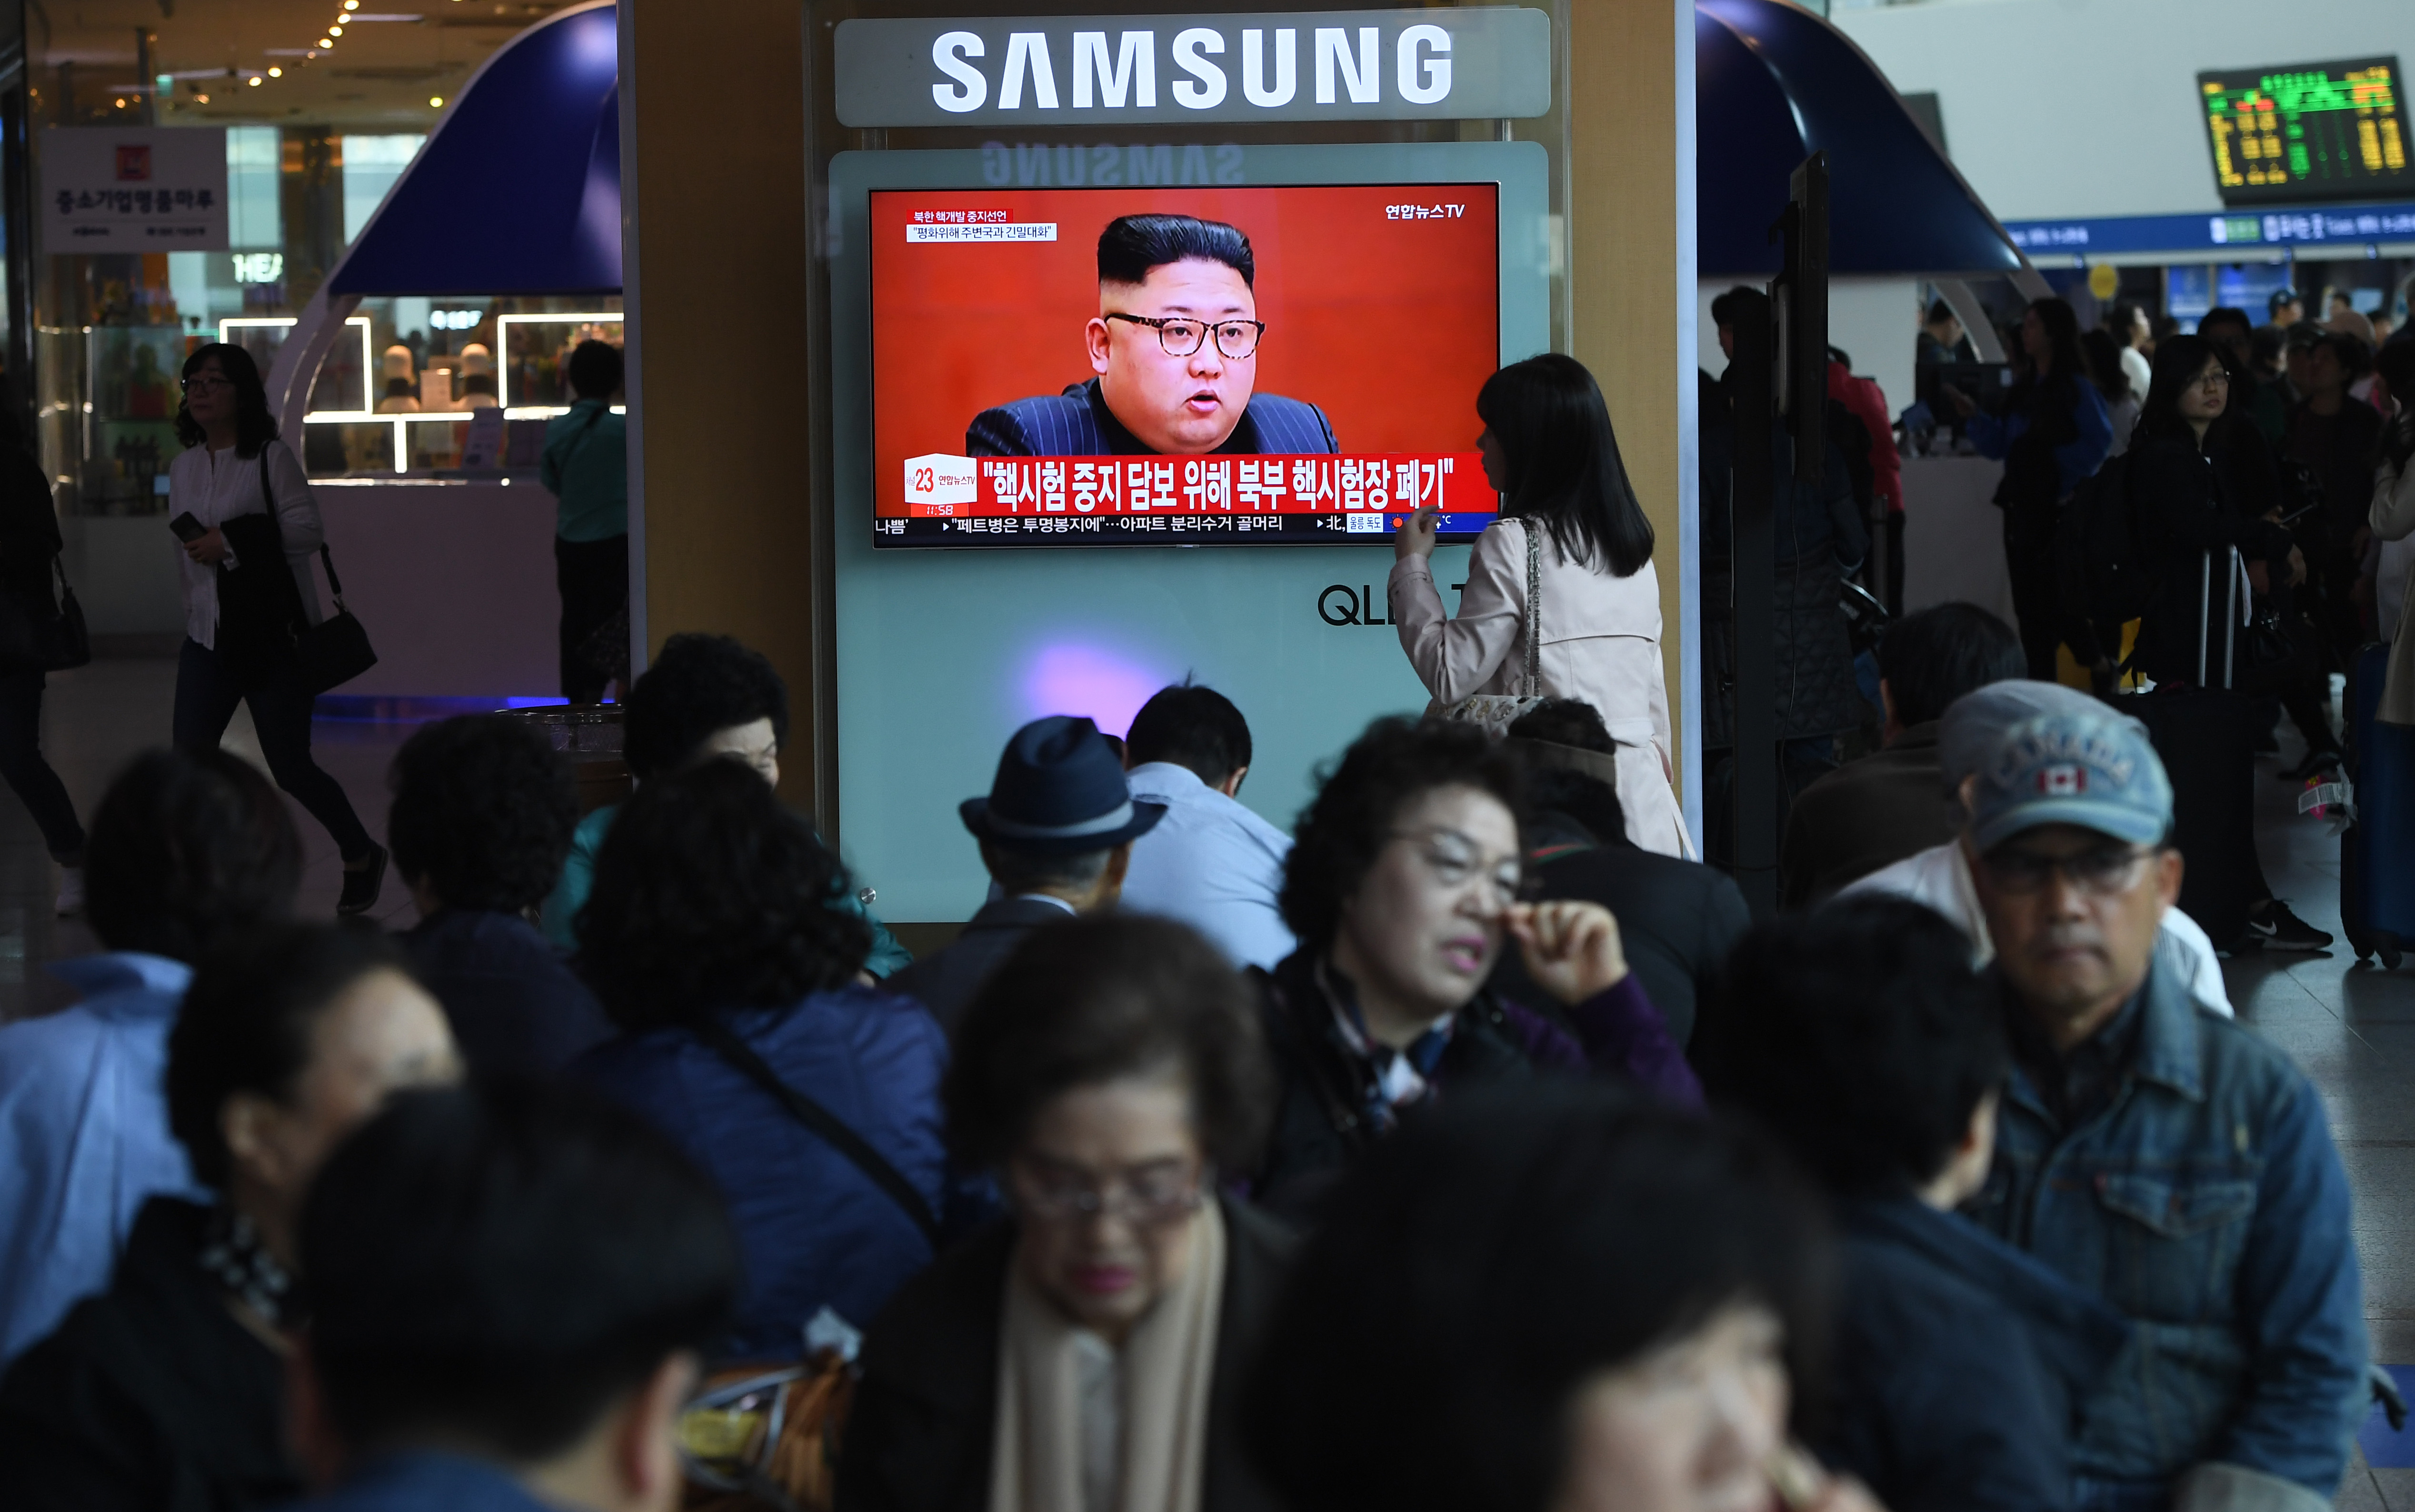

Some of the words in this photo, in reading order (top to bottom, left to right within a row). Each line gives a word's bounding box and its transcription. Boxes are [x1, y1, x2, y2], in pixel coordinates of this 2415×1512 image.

[932, 25, 1452, 113] SAMSUNG
[914, 211, 934, 222] 북한
[936, 211, 965, 222] 핵개발
[967, 210, 1006, 222] 중지선언
[1386, 204, 1465, 219] 연합뉴스TV
[913, 227, 959, 239] "평화위해
[961, 227, 1003, 239] 주변국과
[1006, 226, 1051, 238] 긴밀대화"
[916, 468, 934, 492] 23
[938, 475, 976, 486] 연합뉴스TV
[983, 461, 1066, 512] "핵시험
[1072, 461, 1121, 512] 중지
[1128, 461, 1177, 511] 담보
[1183, 460, 1231, 510] 위해
[1237, 460, 1287, 510] 북부
[1292, 458, 1390, 510] 핵시험장
[1396, 458, 1454, 509] 폐기"
[927, 505, 953, 516] 11:58
[951, 517, 1019, 534] "페트병은
[1170, 516, 1232, 532] 분리수거
[1237, 516, 1282, 531] 골머리
[1350, 517, 1364, 529] 울릉
[1367, 516, 1381, 529] 독도
[1317, 584, 1397, 626] QL
